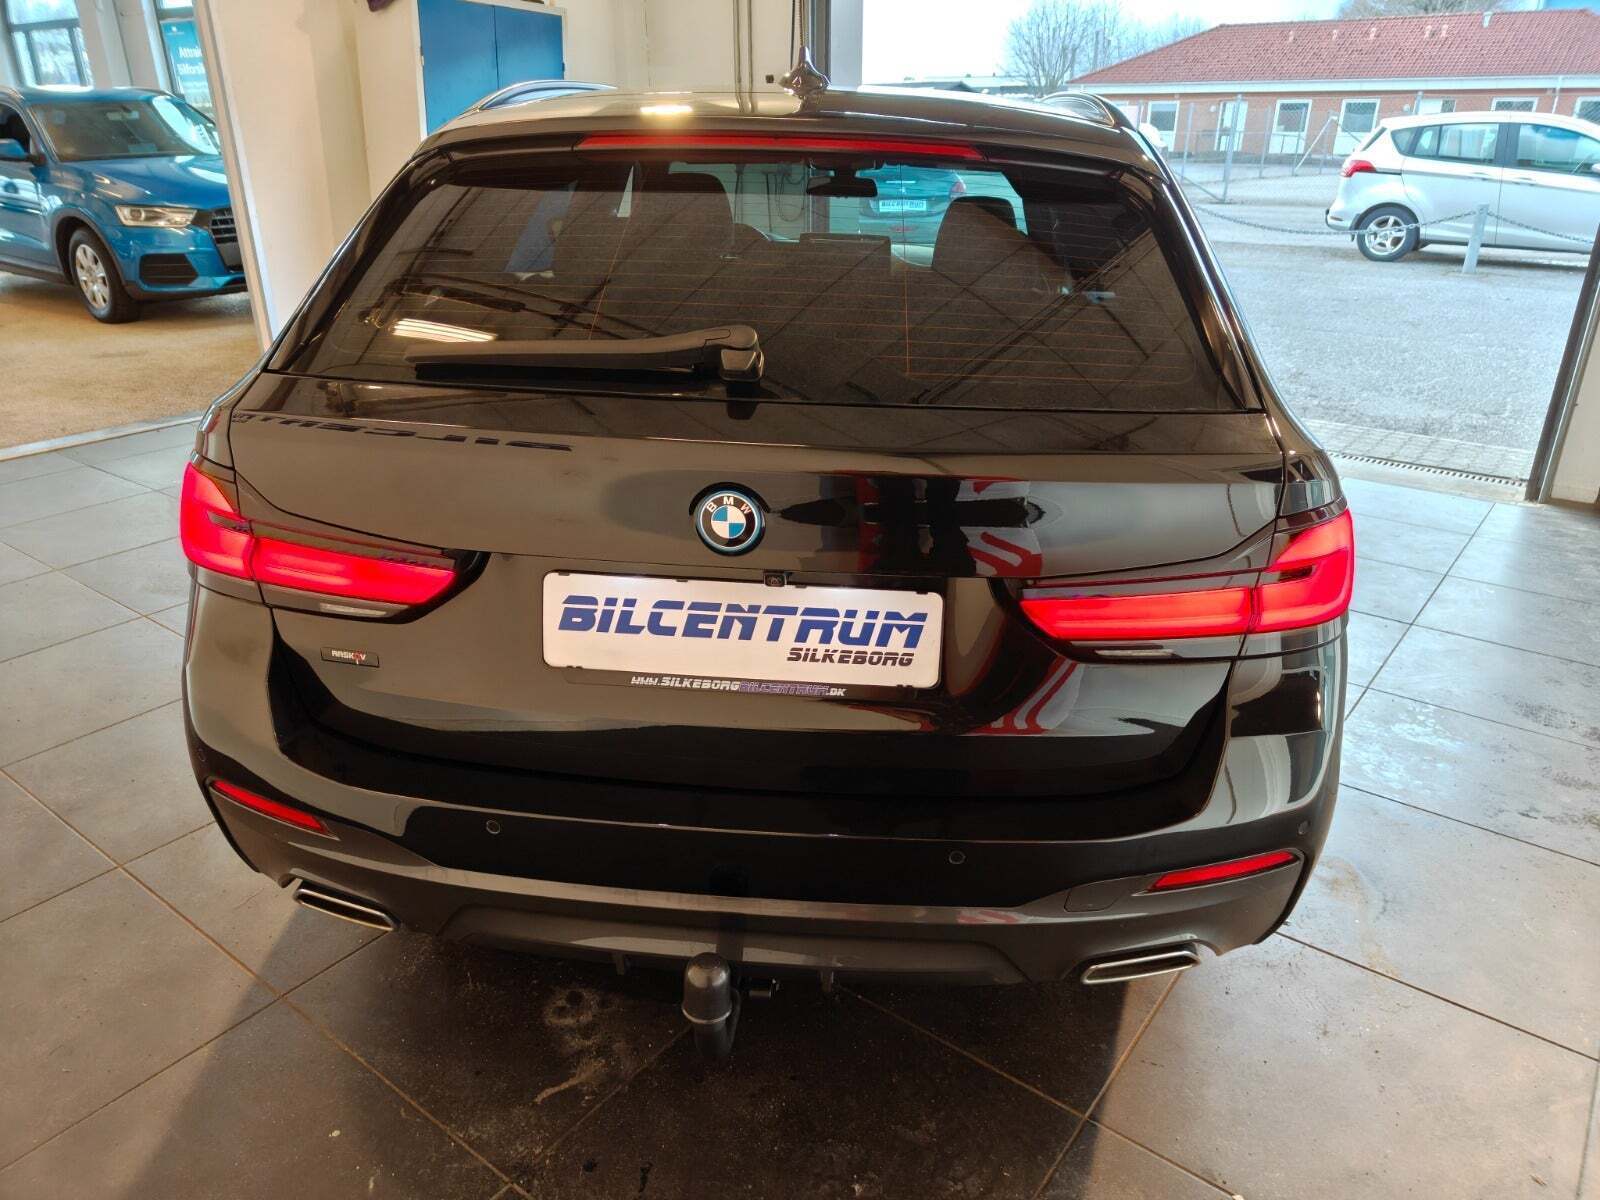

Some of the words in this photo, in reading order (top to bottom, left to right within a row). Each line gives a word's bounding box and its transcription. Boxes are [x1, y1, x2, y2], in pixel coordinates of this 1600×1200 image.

[706, 496, 752, 515] BMW
[558, 594, 929, 649] BILCENTRUM
[786, 647, 915, 667] SILKEBORG
